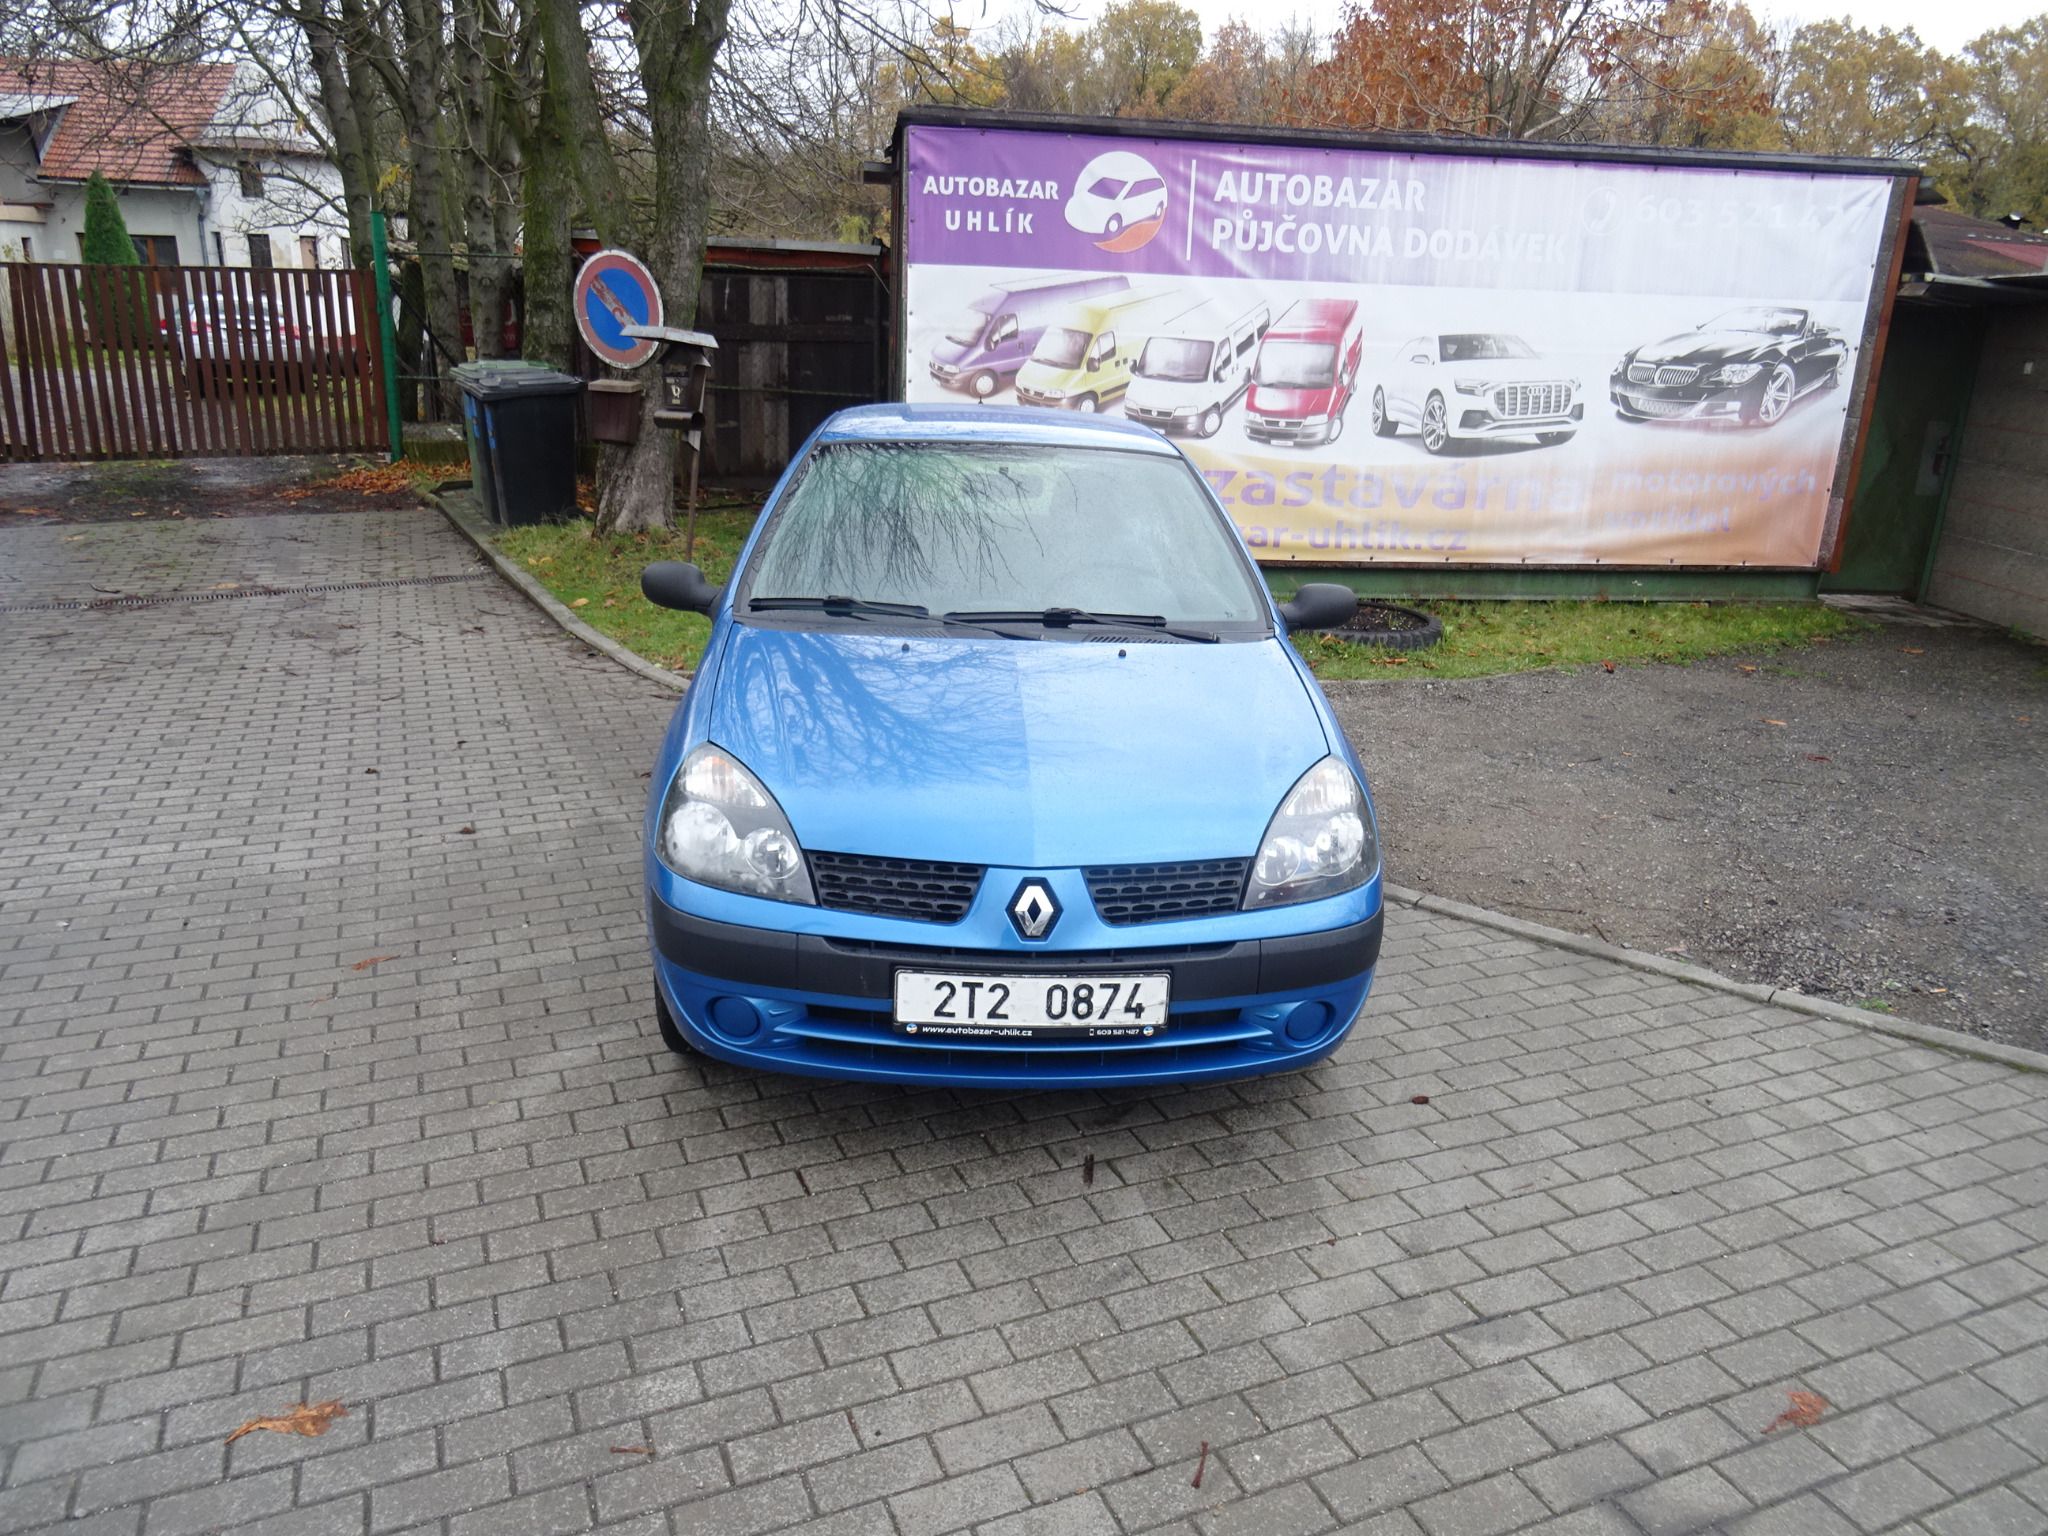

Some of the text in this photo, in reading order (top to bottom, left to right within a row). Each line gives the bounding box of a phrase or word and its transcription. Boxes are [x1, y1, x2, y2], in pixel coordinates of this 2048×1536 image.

[923, 175, 1059, 200] AUTOBAZAR
[1213, 170, 1425, 212] AUTOBAZAR
[945, 208, 1033, 234] UHLÍK
[1637, 196, 1702, 227] 603
[1212, 209, 1395, 257] PŮJČOVNA
[1201, 460, 1816, 512] zastavárna motorových
[933, 981, 1145, 1020] 2T2 0874
[922, 1025, 1032, 1036] www.autobazar-uhlik.cz
